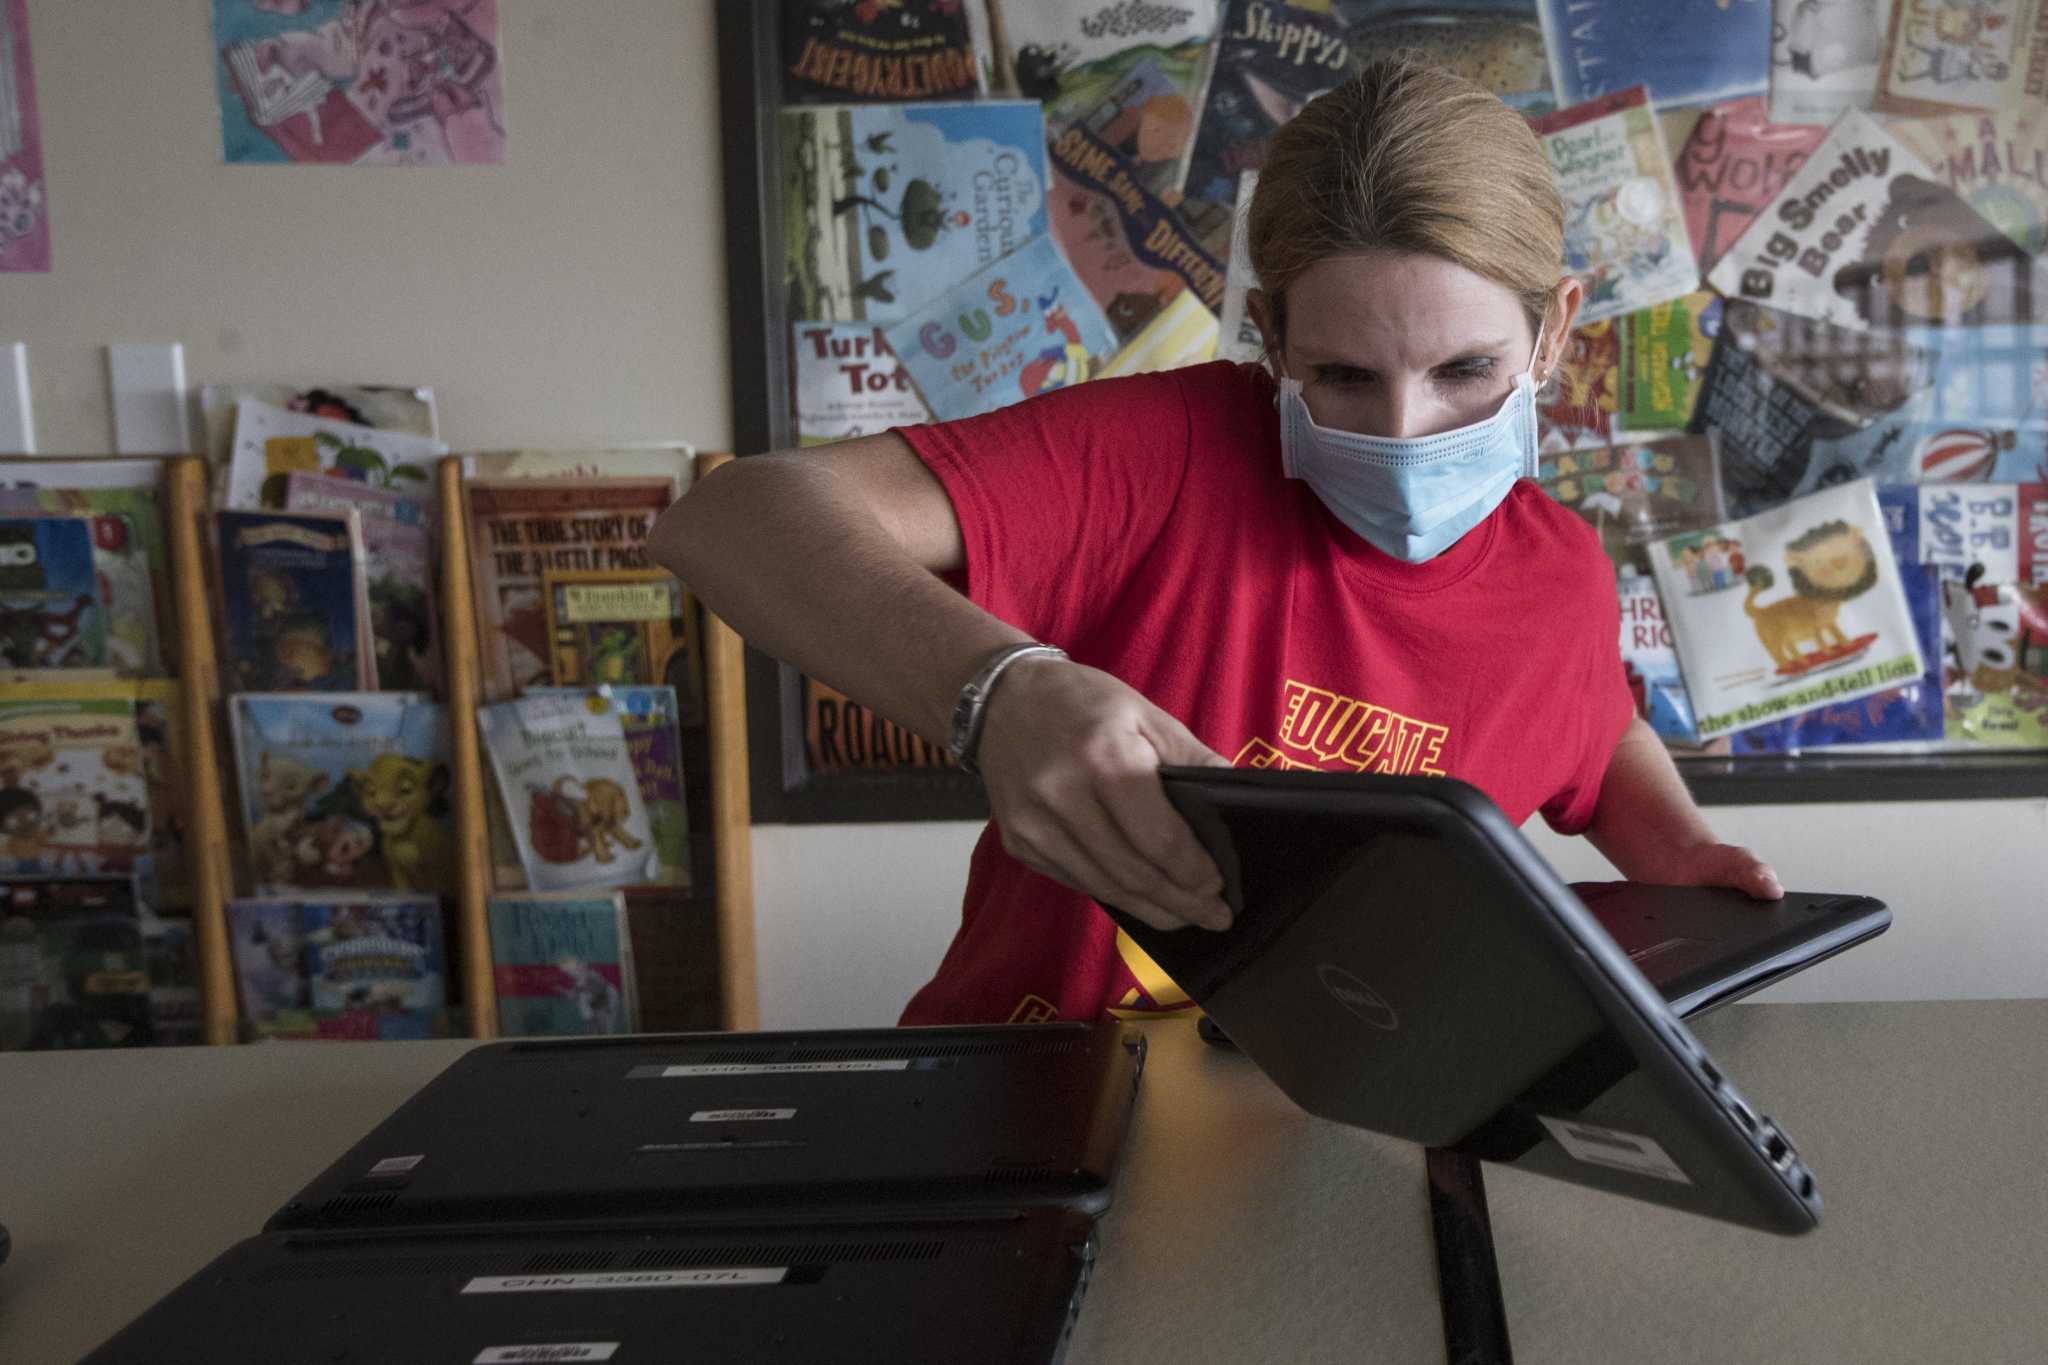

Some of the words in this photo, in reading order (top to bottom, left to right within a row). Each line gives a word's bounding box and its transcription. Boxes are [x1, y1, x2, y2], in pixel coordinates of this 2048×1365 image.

[993, 152, 1020, 256] Curiou
[1740, 231, 1799, 299] Big
[1778, 147, 1897, 232] Smelly
[1797, 203, 1867, 279] Bear
[489, 520, 521, 544] THE
[571, 514, 623, 542] STORY
[1279, 680, 1449, 775] EDUCATE
